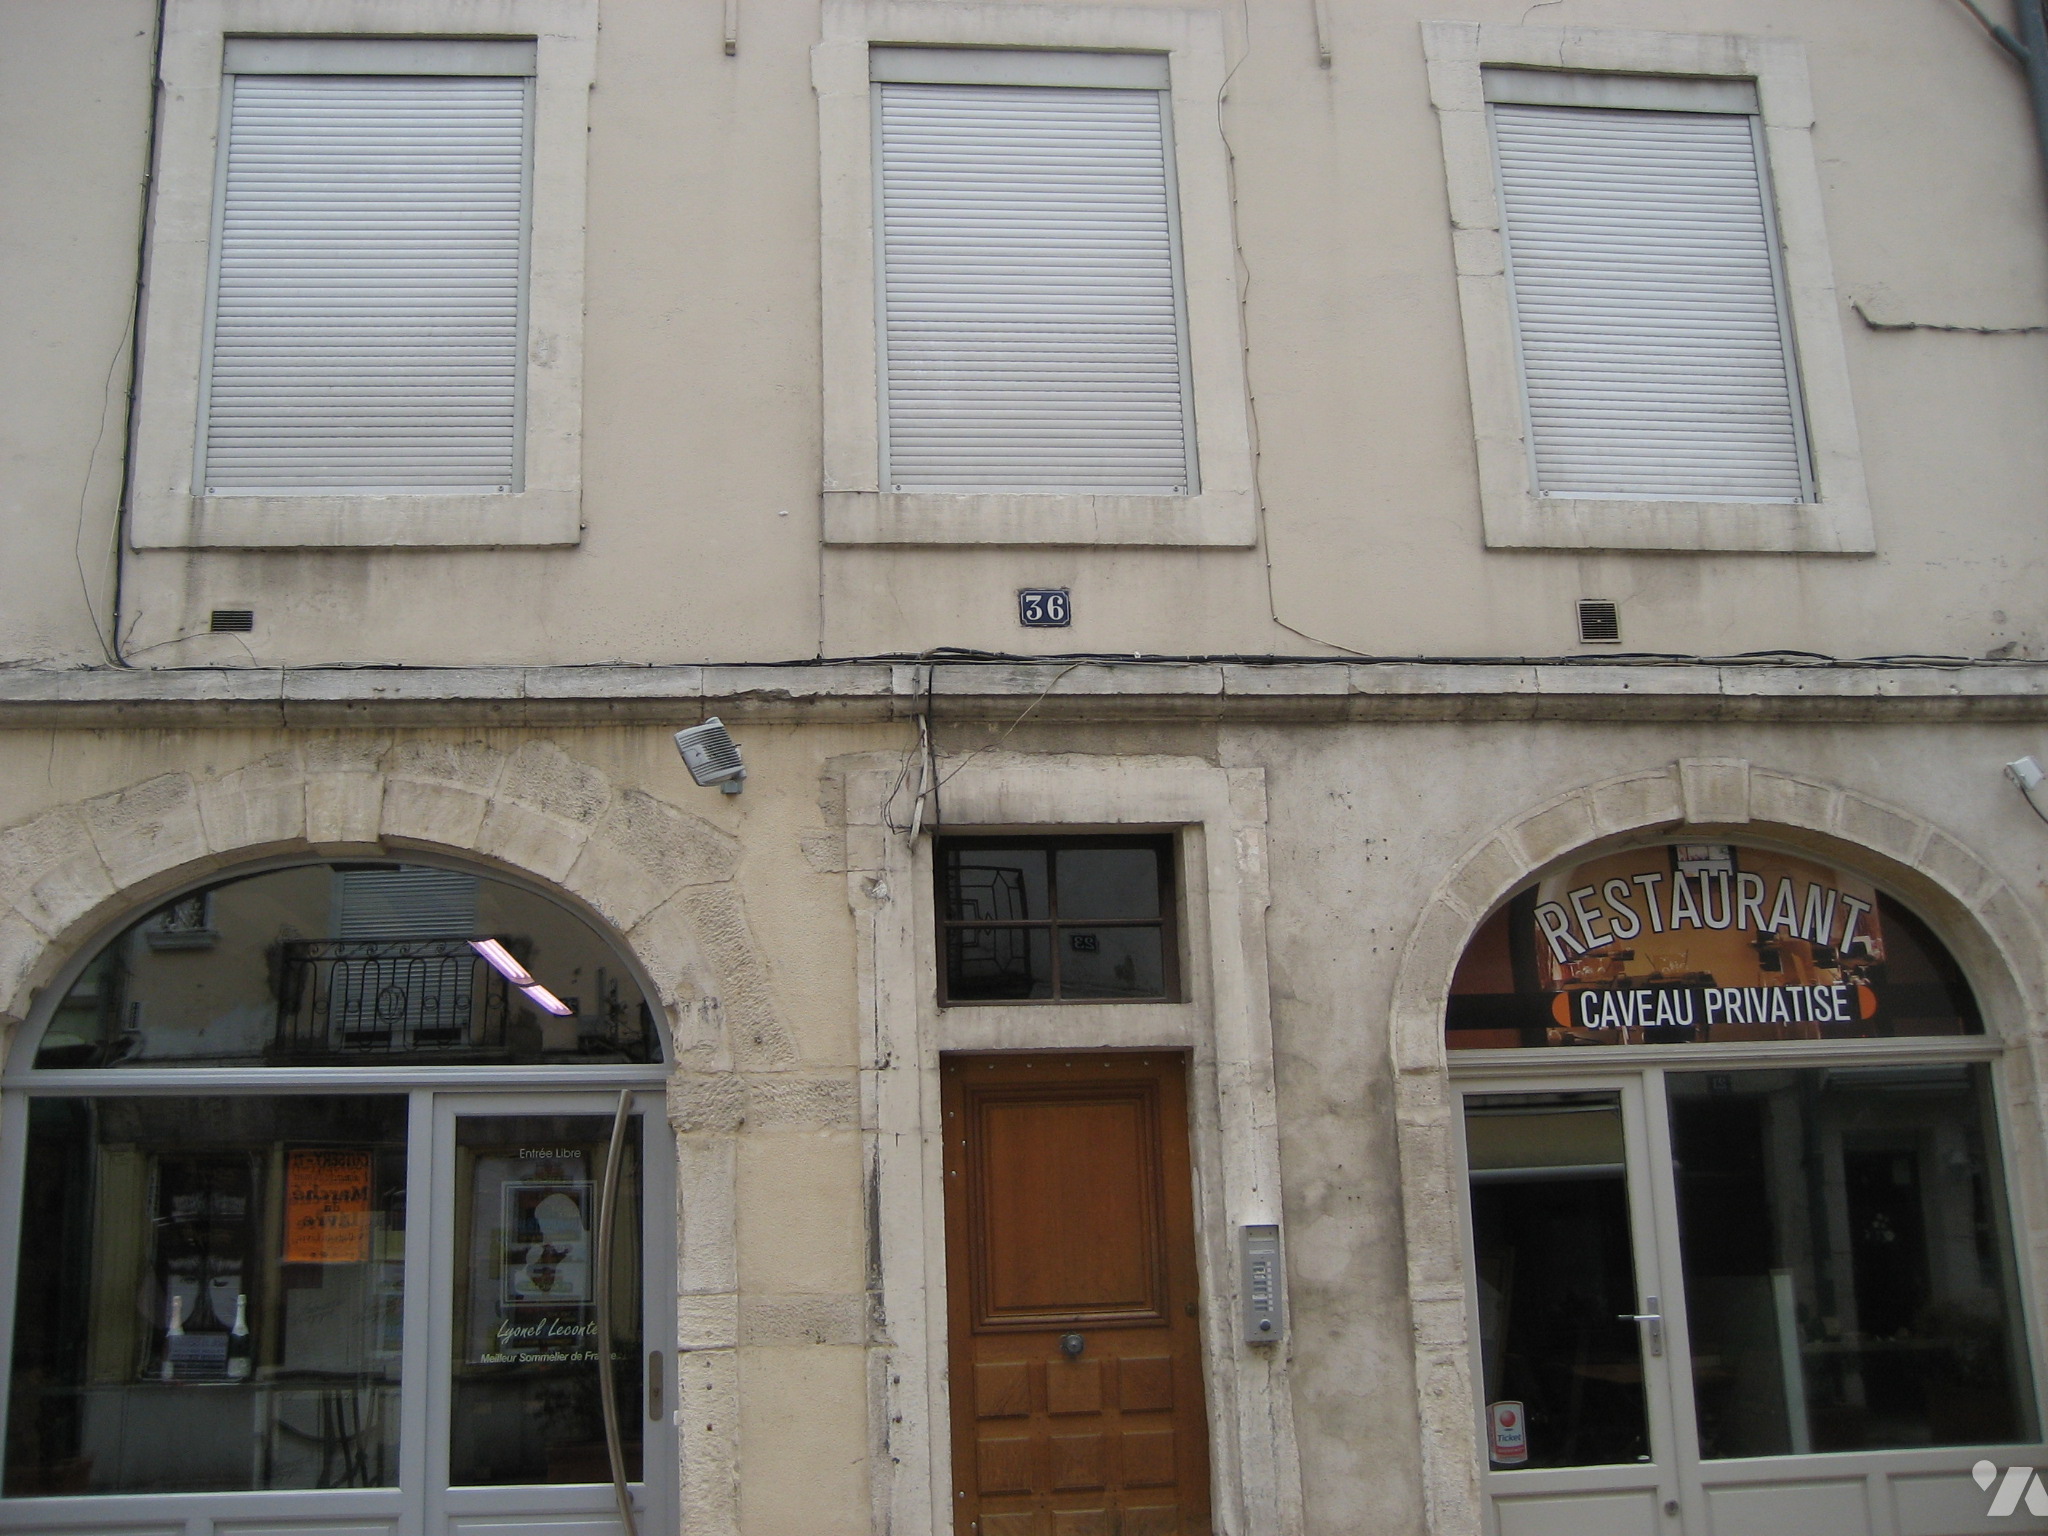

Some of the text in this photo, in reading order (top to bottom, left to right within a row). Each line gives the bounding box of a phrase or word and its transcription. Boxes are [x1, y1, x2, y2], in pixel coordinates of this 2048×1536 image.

[1025, 595, 1064, 620] 36
[1533, 868, 1872, 965] RESTAURANT
[1580, 988, 1694, 1029] CAVEAU
[519, 1148, 582, 1159] Entrée Libre
[497, 1317, 547, 1344] Lyonel
[480, 1352, 517, 1364] Meilleur
[519, 1350, 569, 1363] Sommelier
[571, 1350, 583, 1362] de
[1498, 1433, 1521, 1441] Ticket
